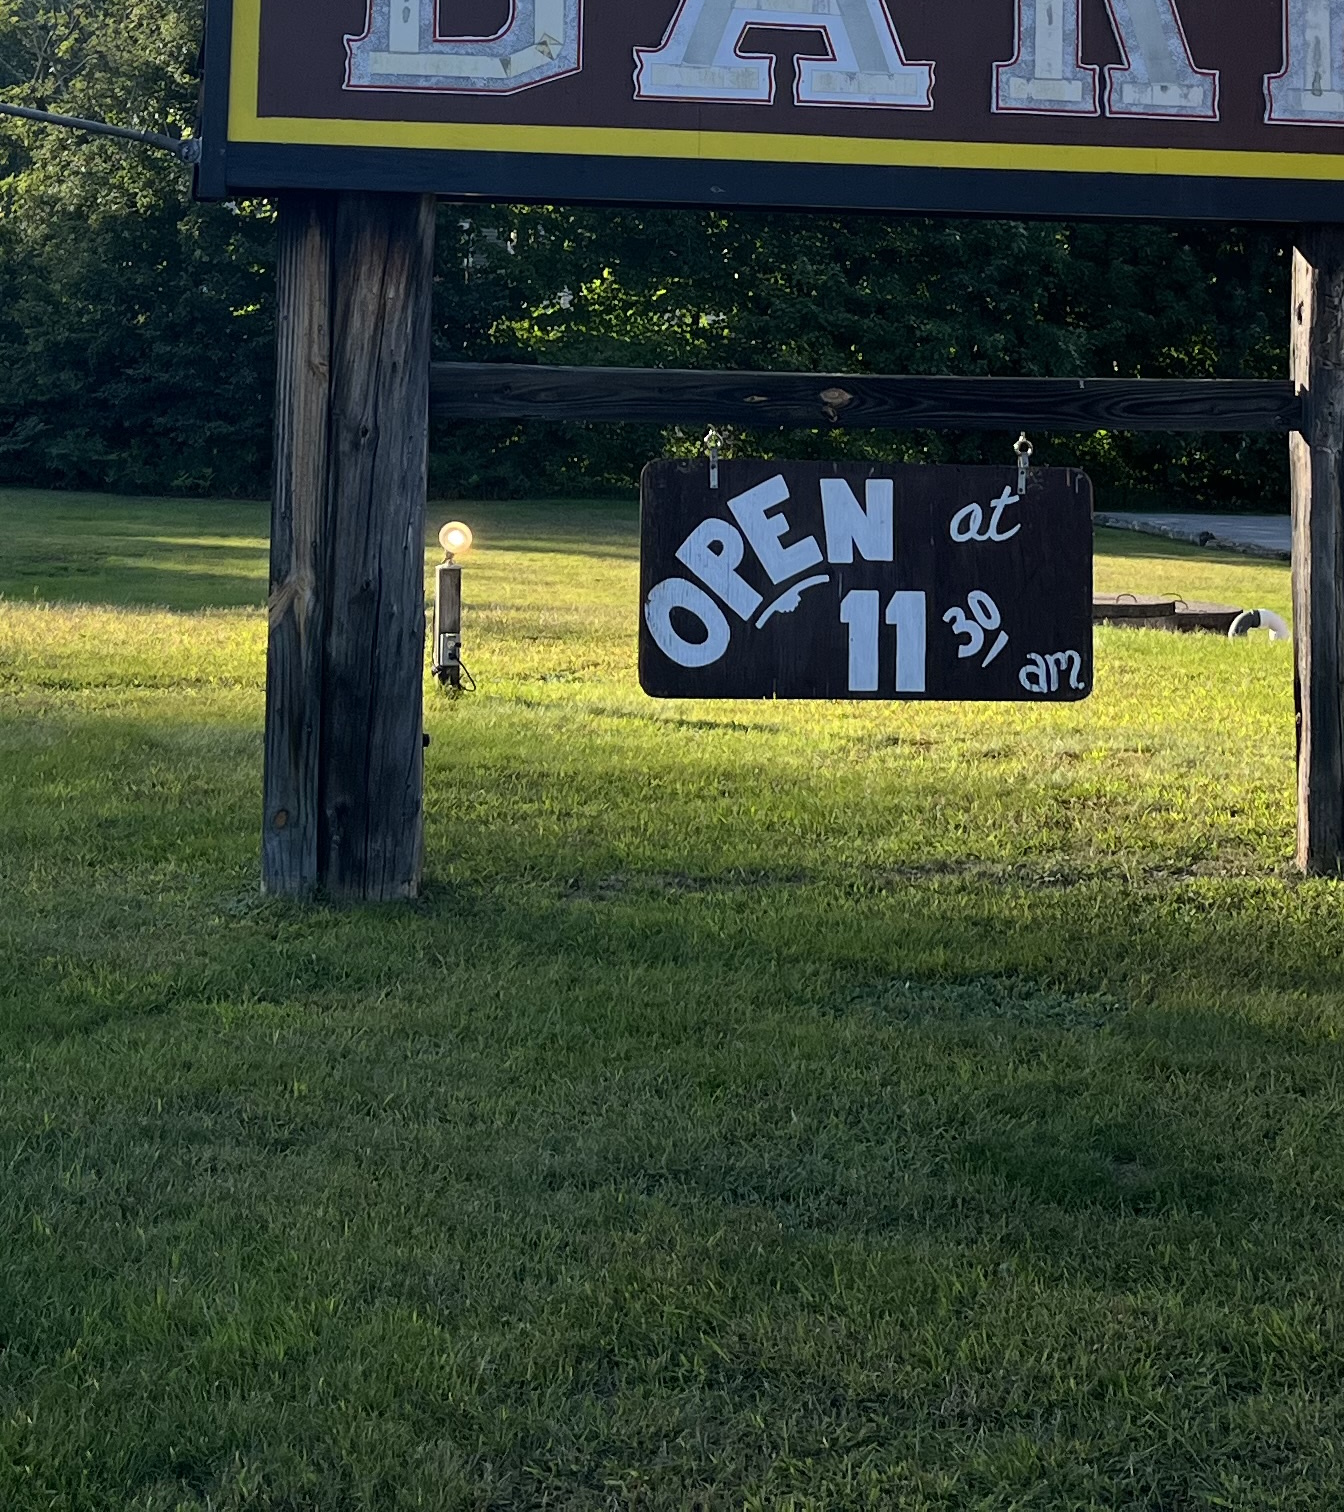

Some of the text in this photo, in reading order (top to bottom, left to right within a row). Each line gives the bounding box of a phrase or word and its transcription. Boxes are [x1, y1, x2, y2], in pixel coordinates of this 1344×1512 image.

[645, 474, 1021, 668] OPEN at
[840, 589, 926, 692] 11
